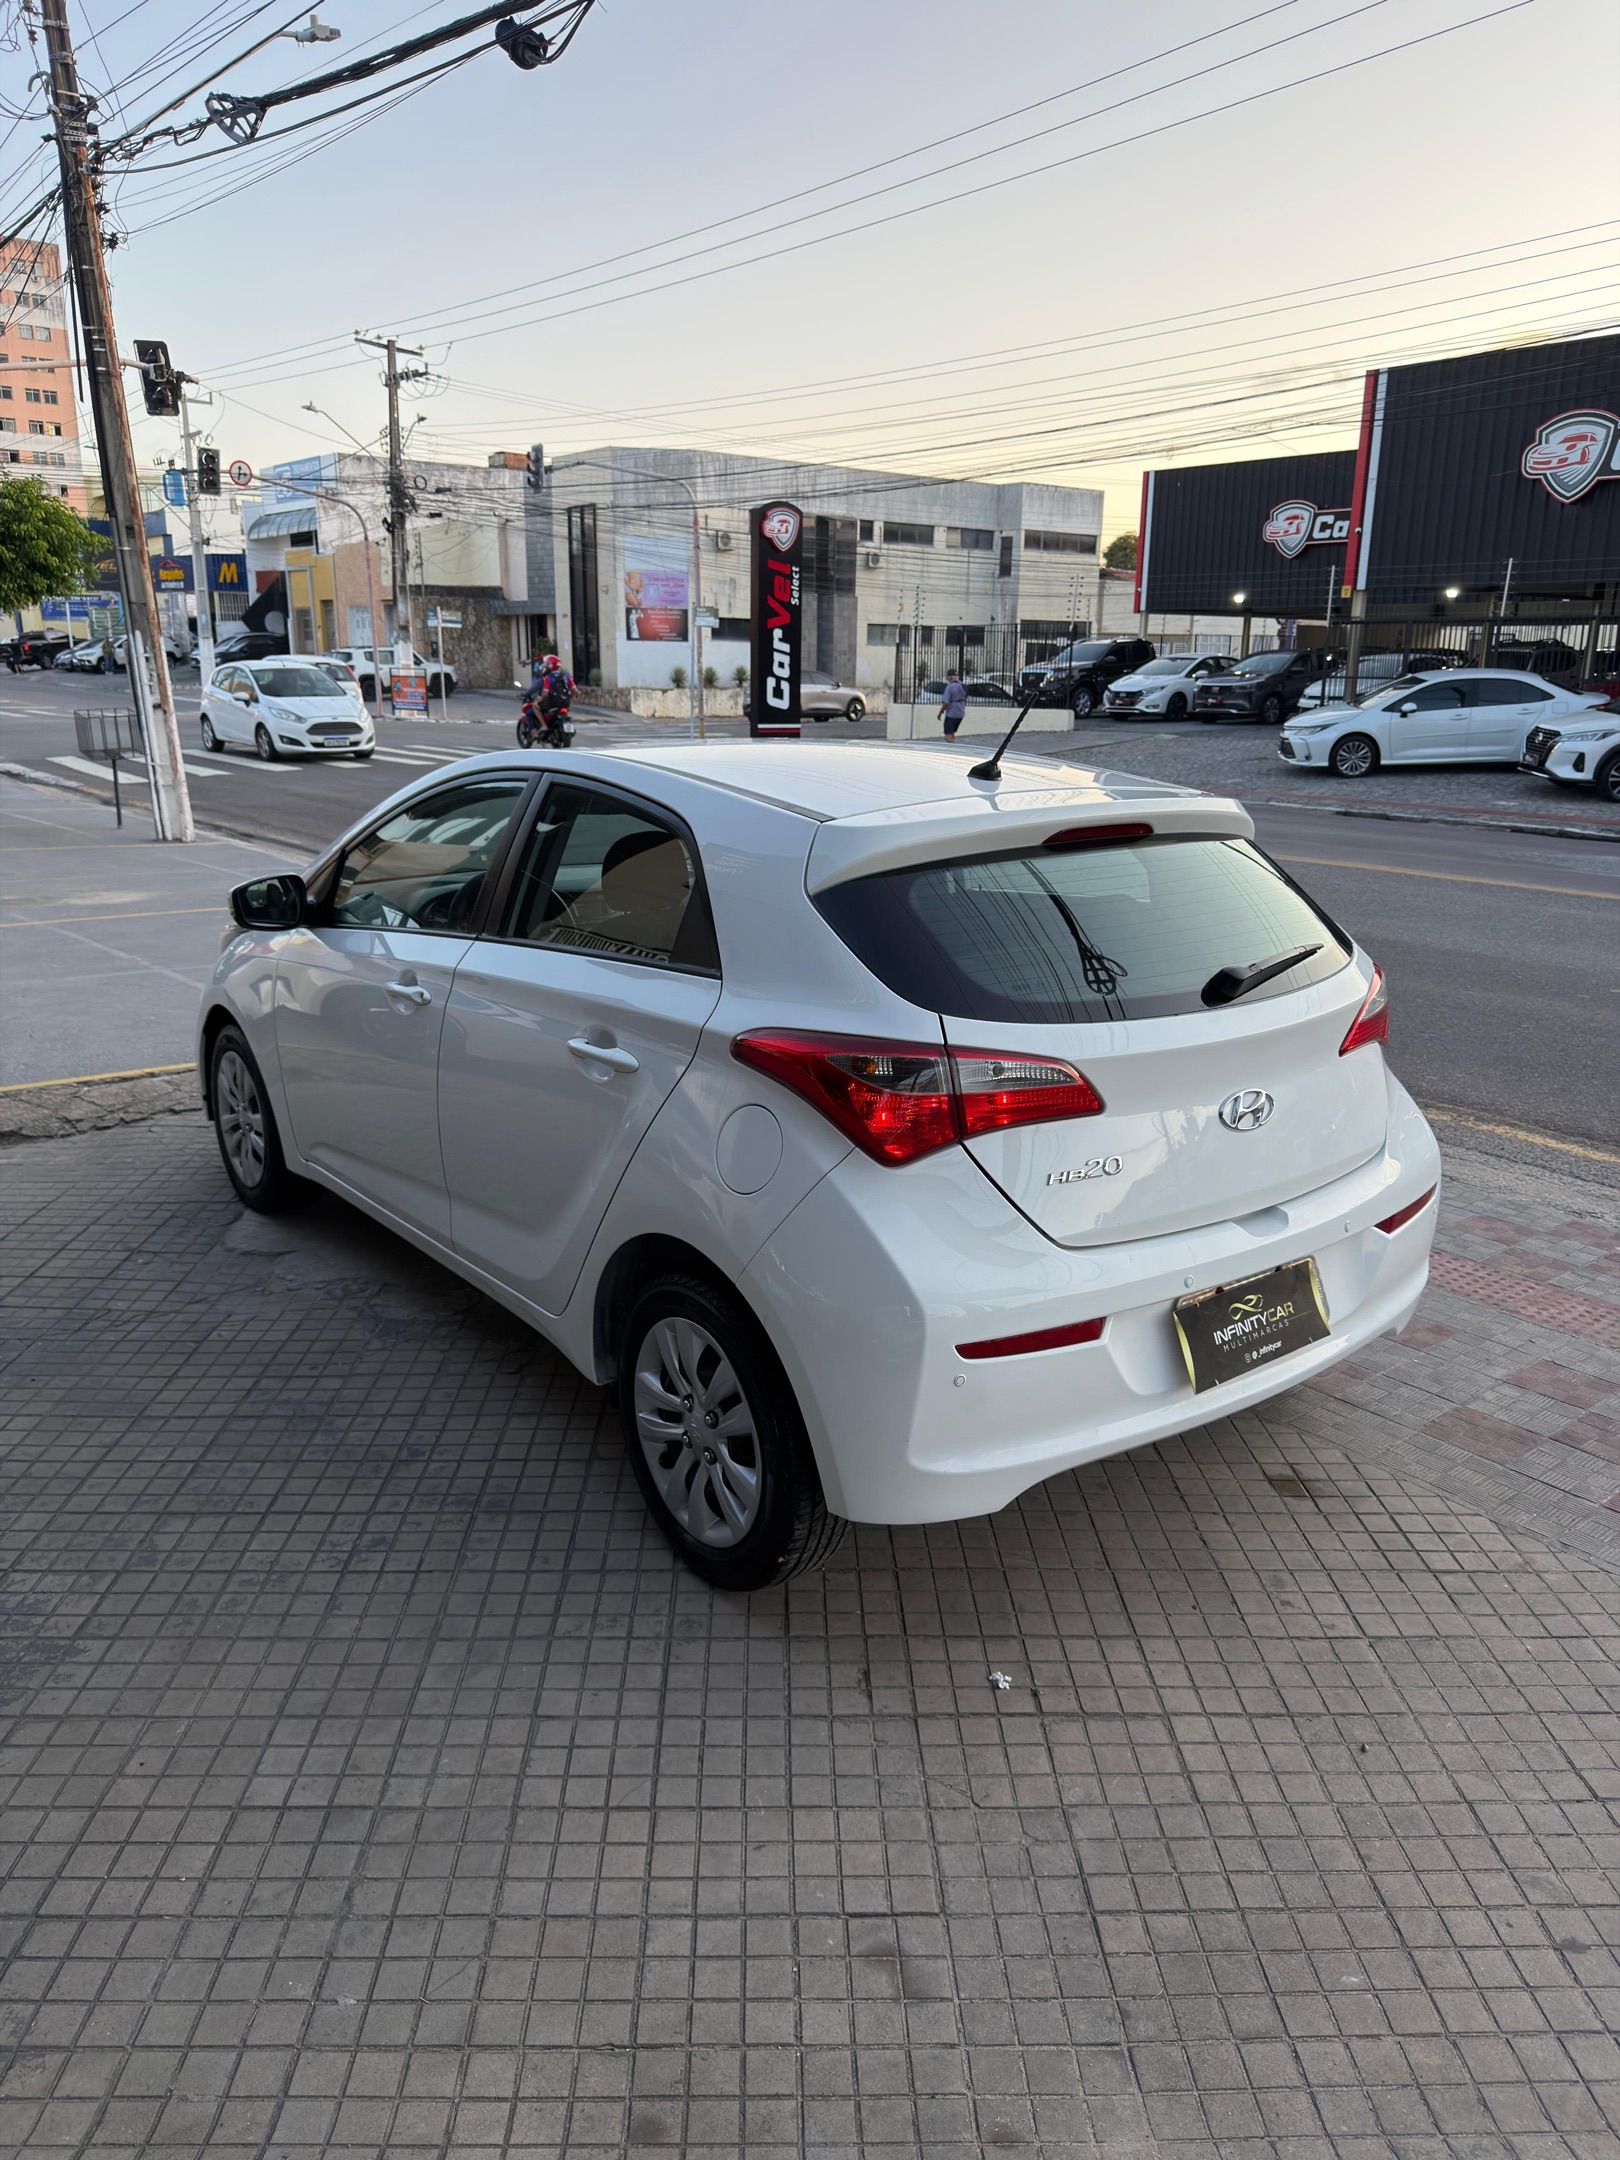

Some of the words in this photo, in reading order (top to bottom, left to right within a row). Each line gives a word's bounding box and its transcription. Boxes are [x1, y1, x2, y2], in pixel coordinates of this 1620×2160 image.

[218, 562, 239, 584] M
[791, 566, 800, 606] Select
[766, 559, 791, 710] CarVel
[1046, 1155, 1124, 1187] HB20
[1213, 1301, 1295, 1346] INFINITYCAR
[1222, 1318, 1290, 1353] MULTIMARCAS
